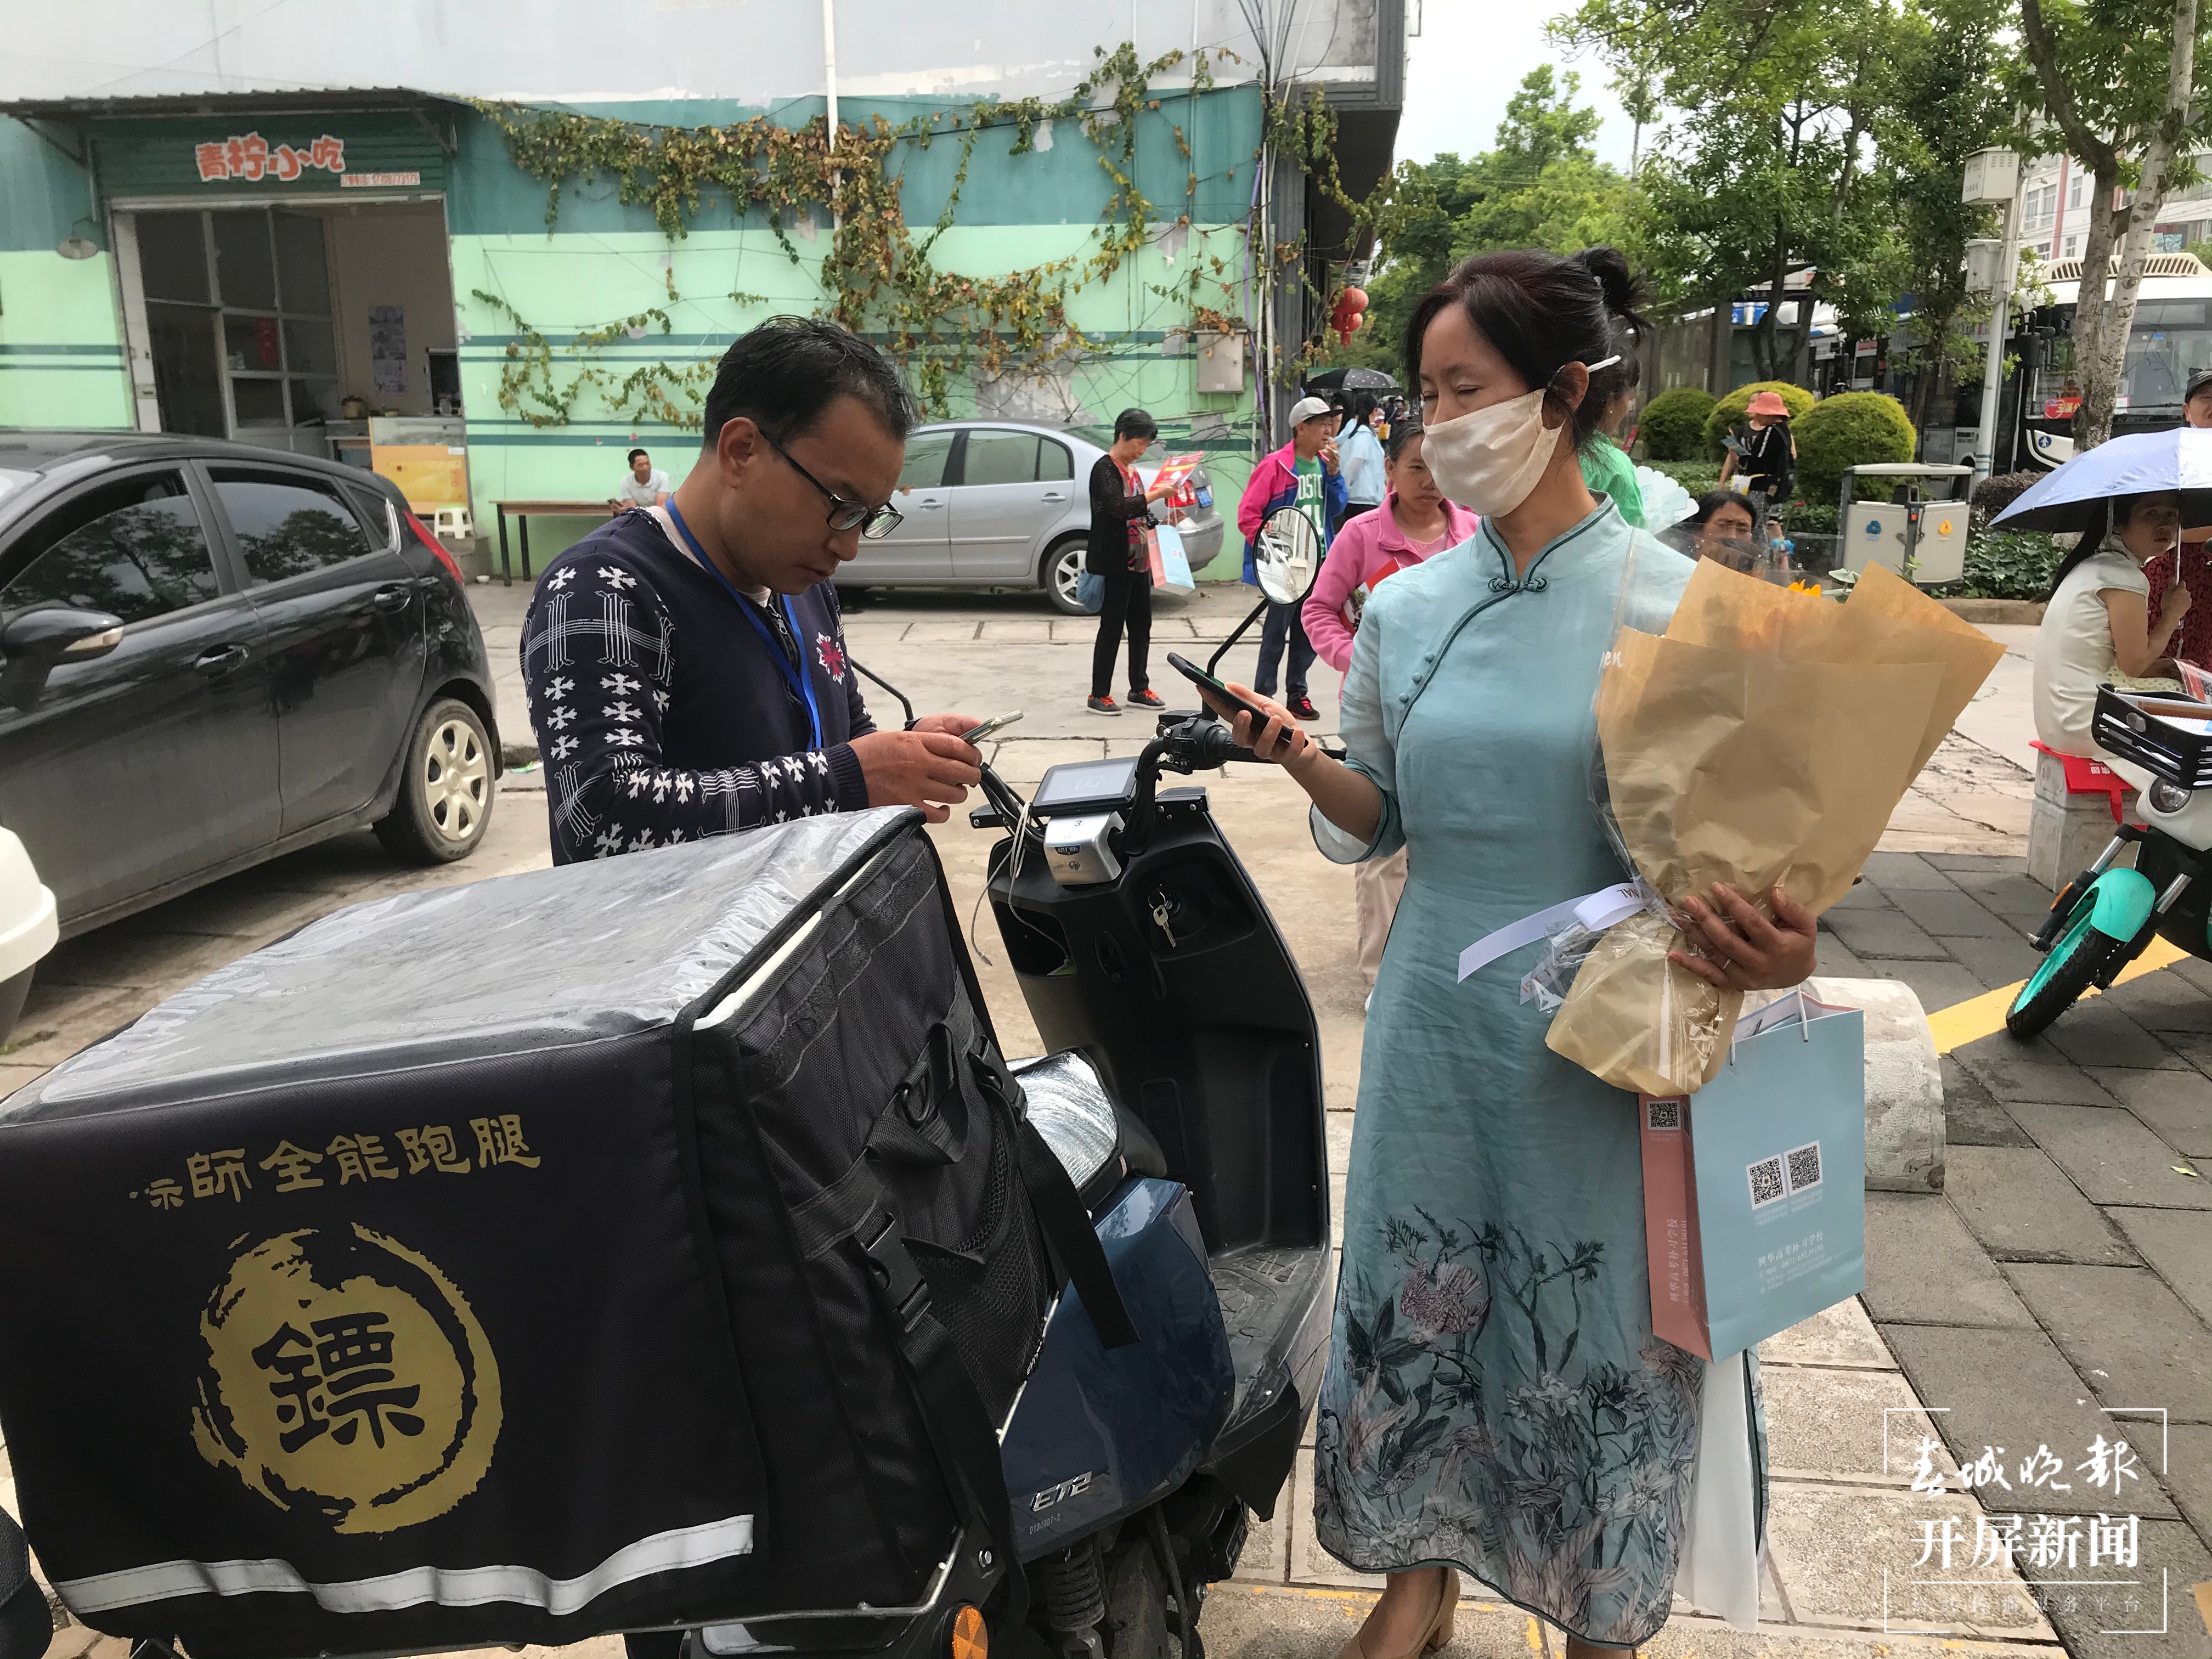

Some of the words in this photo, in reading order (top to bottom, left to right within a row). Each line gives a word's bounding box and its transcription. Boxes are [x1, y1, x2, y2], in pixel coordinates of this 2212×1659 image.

[195, 132, 346, 181] 青柠小吃
[1298, 473, 1324, 500] OSTO
[1030, 1471, 1092, 1512] ET2
